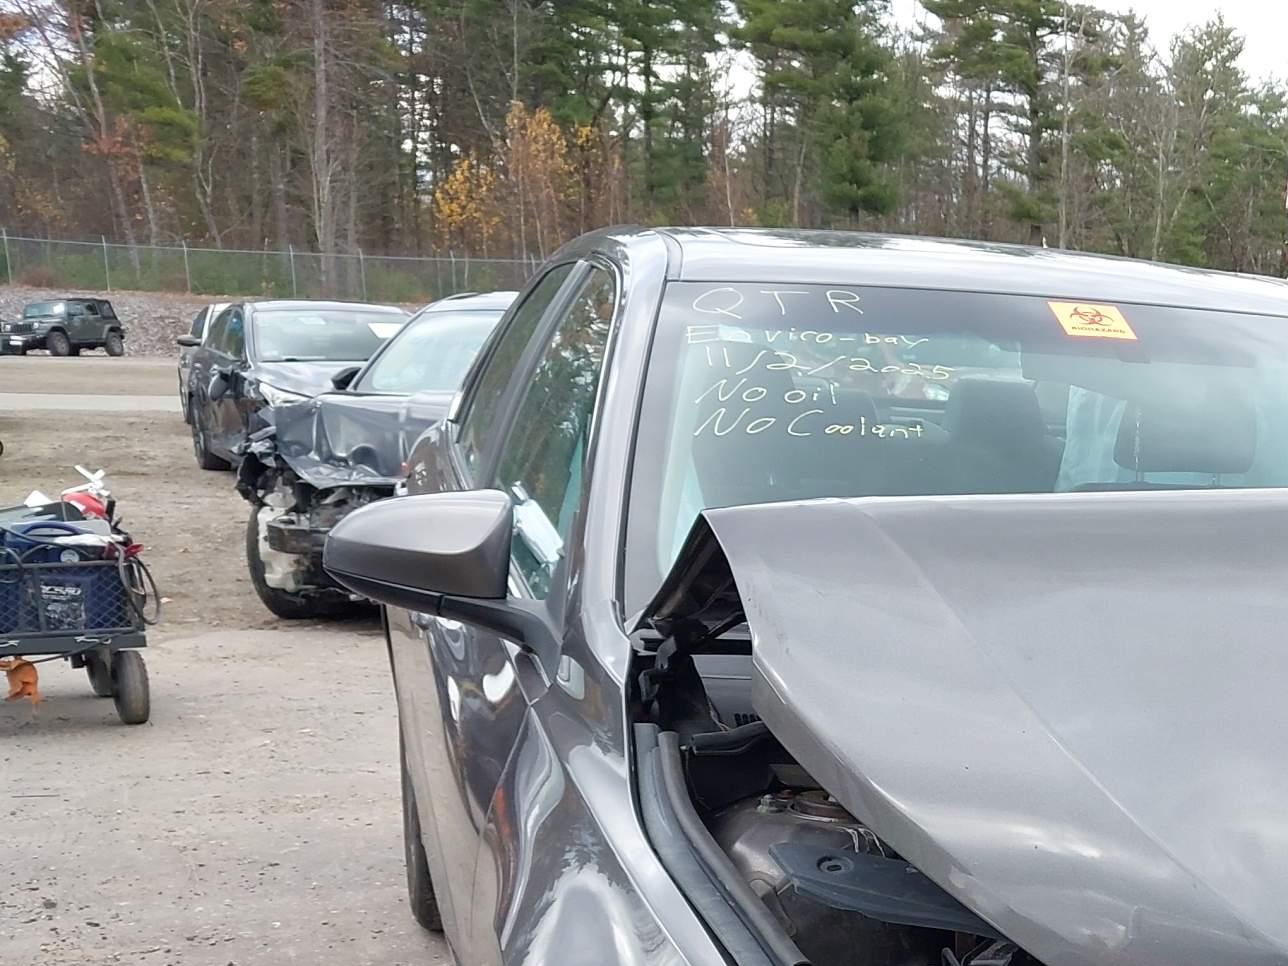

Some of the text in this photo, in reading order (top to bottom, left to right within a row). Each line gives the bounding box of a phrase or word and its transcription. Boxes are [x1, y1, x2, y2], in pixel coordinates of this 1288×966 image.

[695, 377, 767, 404] No
[693, 408, 925, 438] No Coolant
